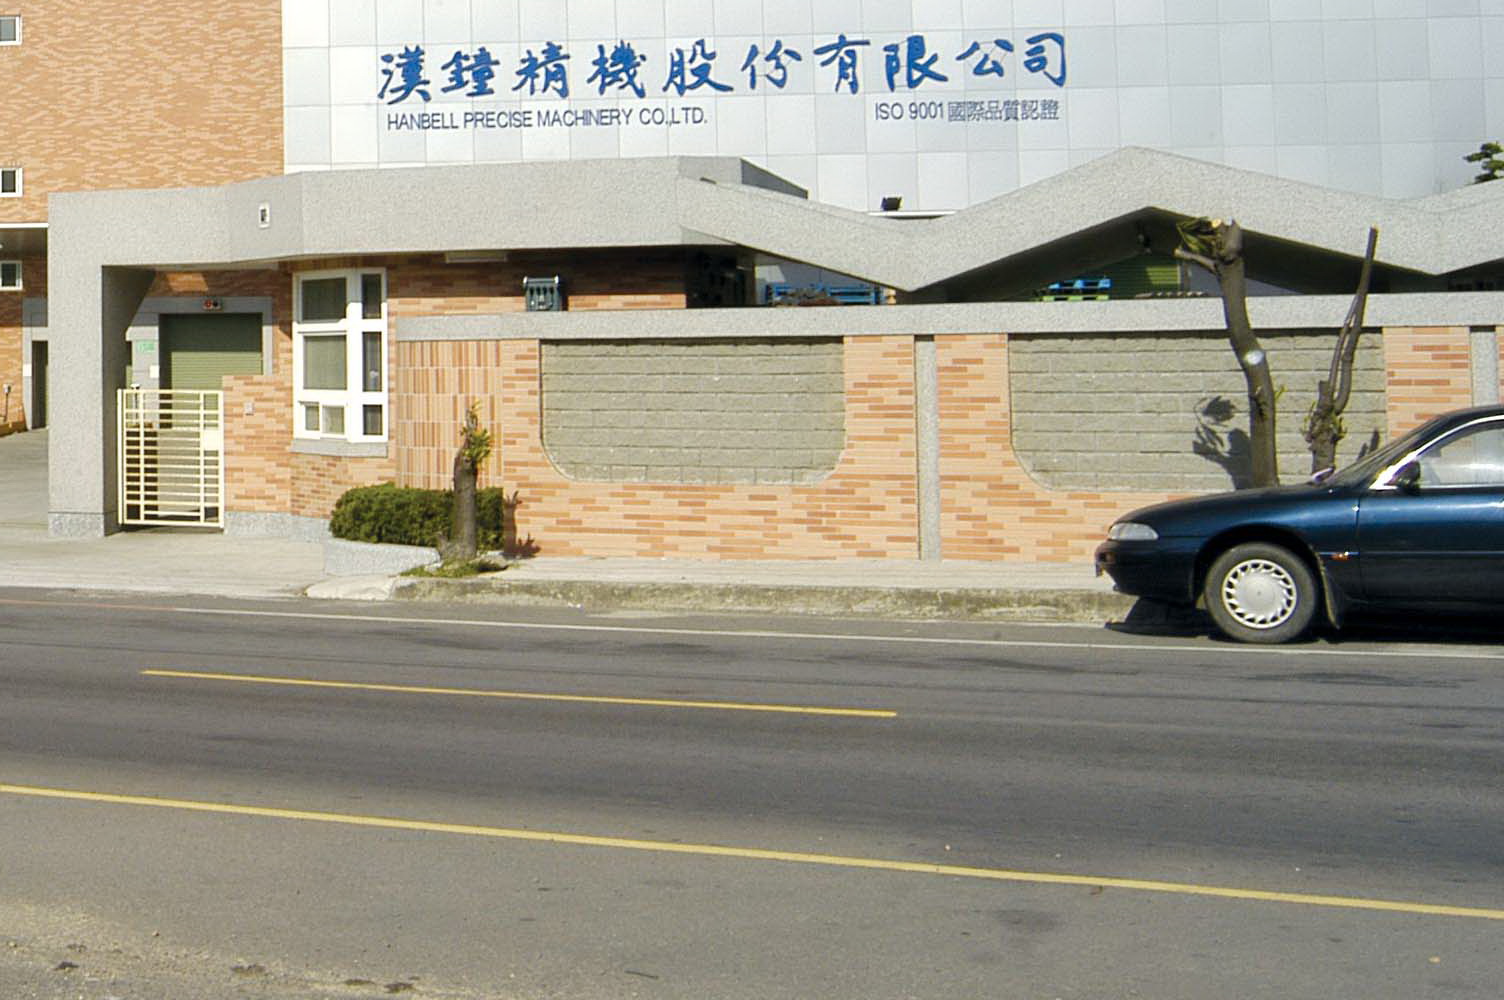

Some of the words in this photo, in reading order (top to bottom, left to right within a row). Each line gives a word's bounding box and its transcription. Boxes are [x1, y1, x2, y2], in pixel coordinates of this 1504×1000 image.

[377, 32, 1067, 105] 漢鐘精機股份有限公司
[387, 112, 459, 130] HANBELL
[463, 110, 533, 128] PRECISE
[537, 108, 633, 127] MACHINERY
[875, 102, 904, 120] ISO
[908, 101, 944, 120] 9001
